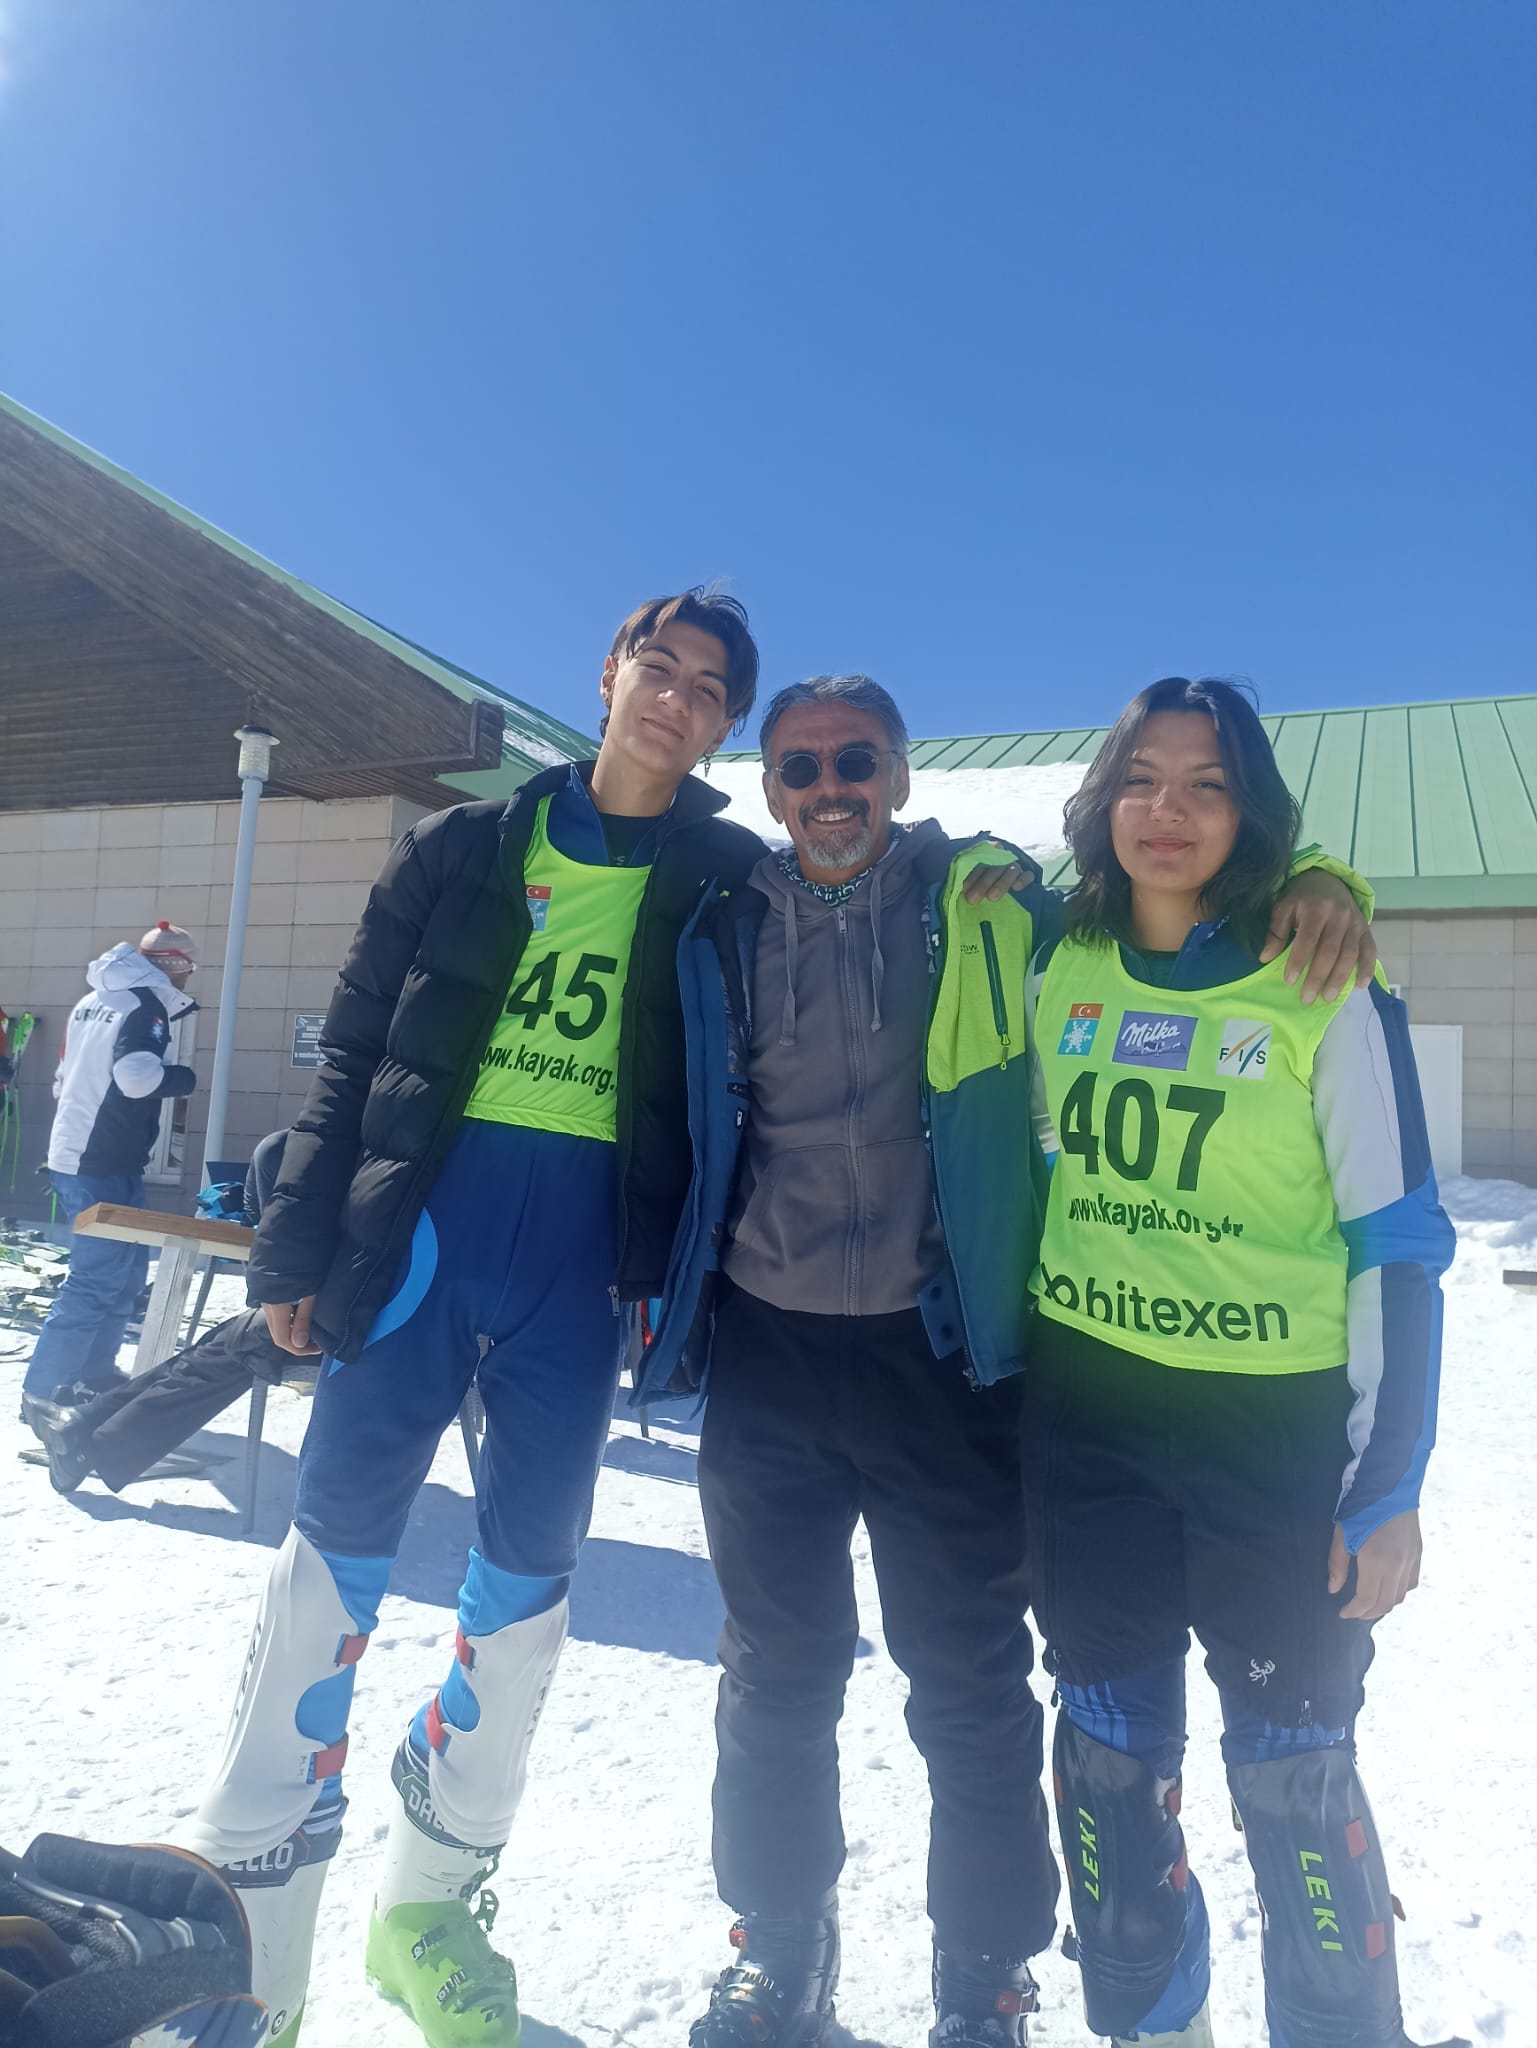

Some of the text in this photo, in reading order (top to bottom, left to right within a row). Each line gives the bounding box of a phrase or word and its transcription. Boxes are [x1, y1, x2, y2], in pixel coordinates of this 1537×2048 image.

[506, 951, 618, 1041] 45
[1122, 1020, 1181, 1047] Milka
[1219, 1047, 1266, 1065] FIS
[1060, 1070, 1226, 1192] 407
[1078, 1807, 1100, 1902] LEKI
[1299, 1850, 1344, 1952] LEKI
